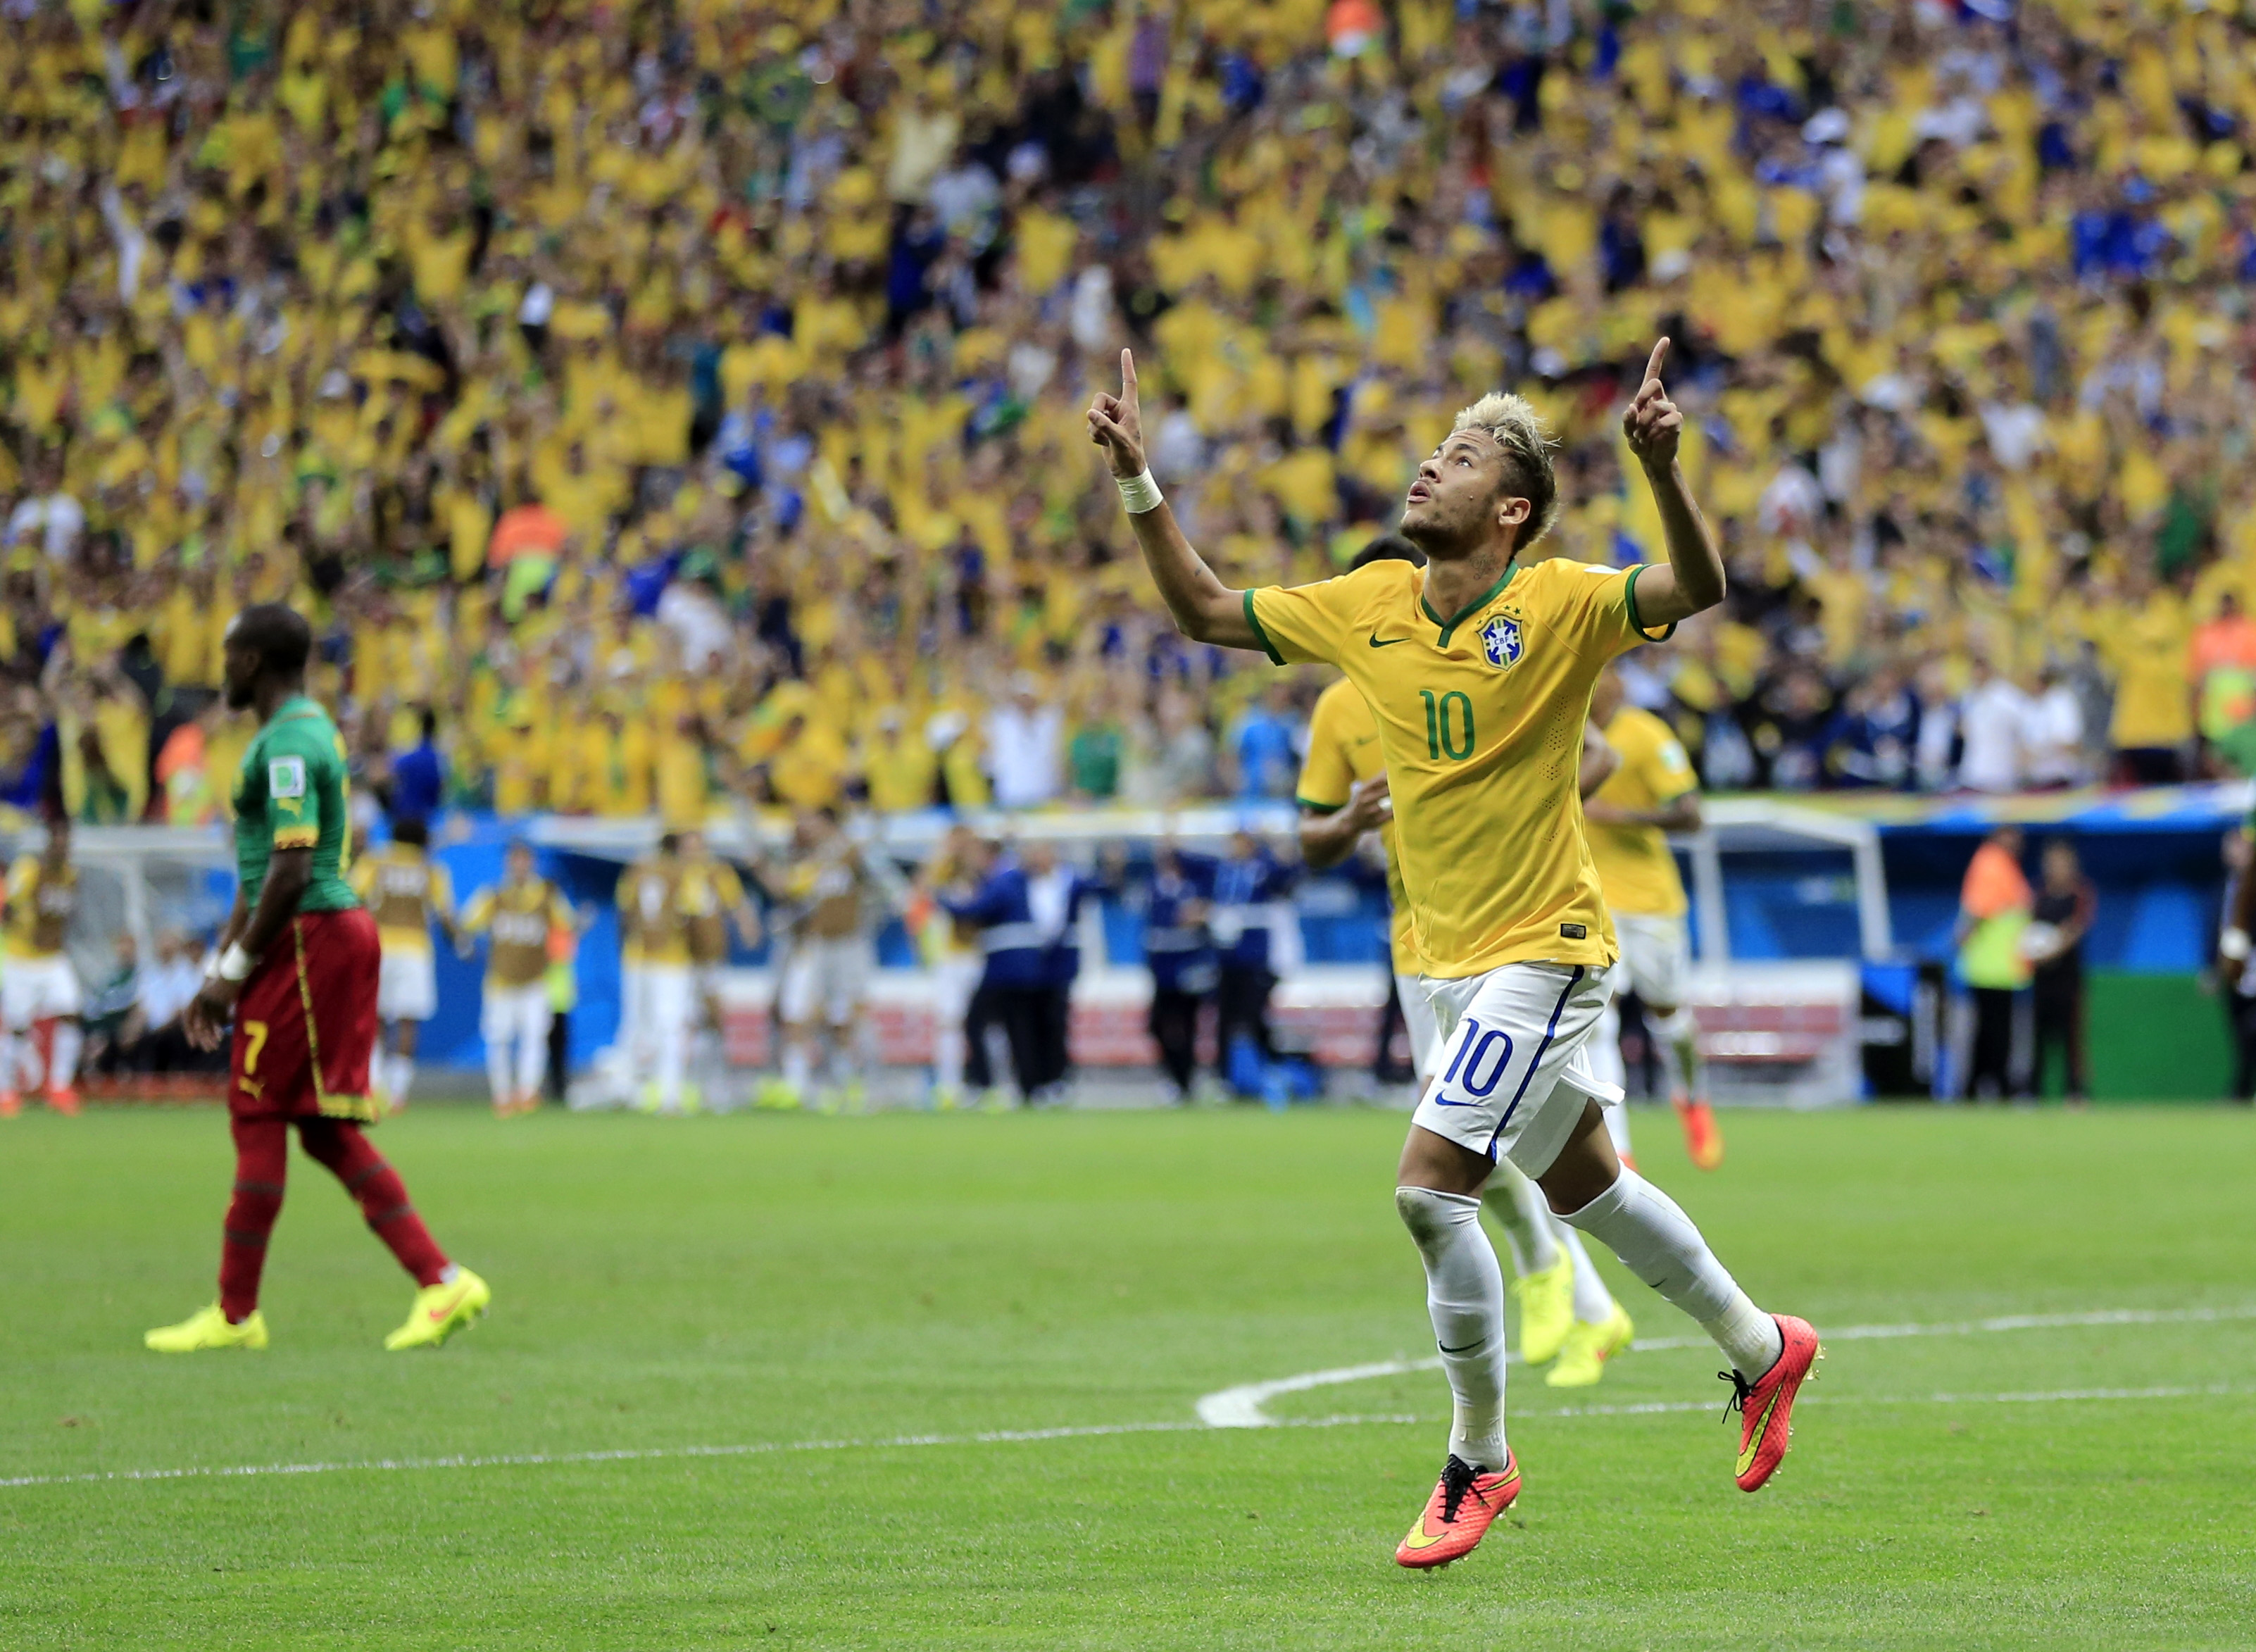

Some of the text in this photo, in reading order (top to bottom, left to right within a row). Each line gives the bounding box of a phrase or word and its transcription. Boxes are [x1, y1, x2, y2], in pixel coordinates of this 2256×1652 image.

[1494, 636, 1510, 646] CBF
[1420, 690, 1475, 761] 10
[244, 1020, 268, 1075] 7
[1443, 1018, 1513, 1096] 10
